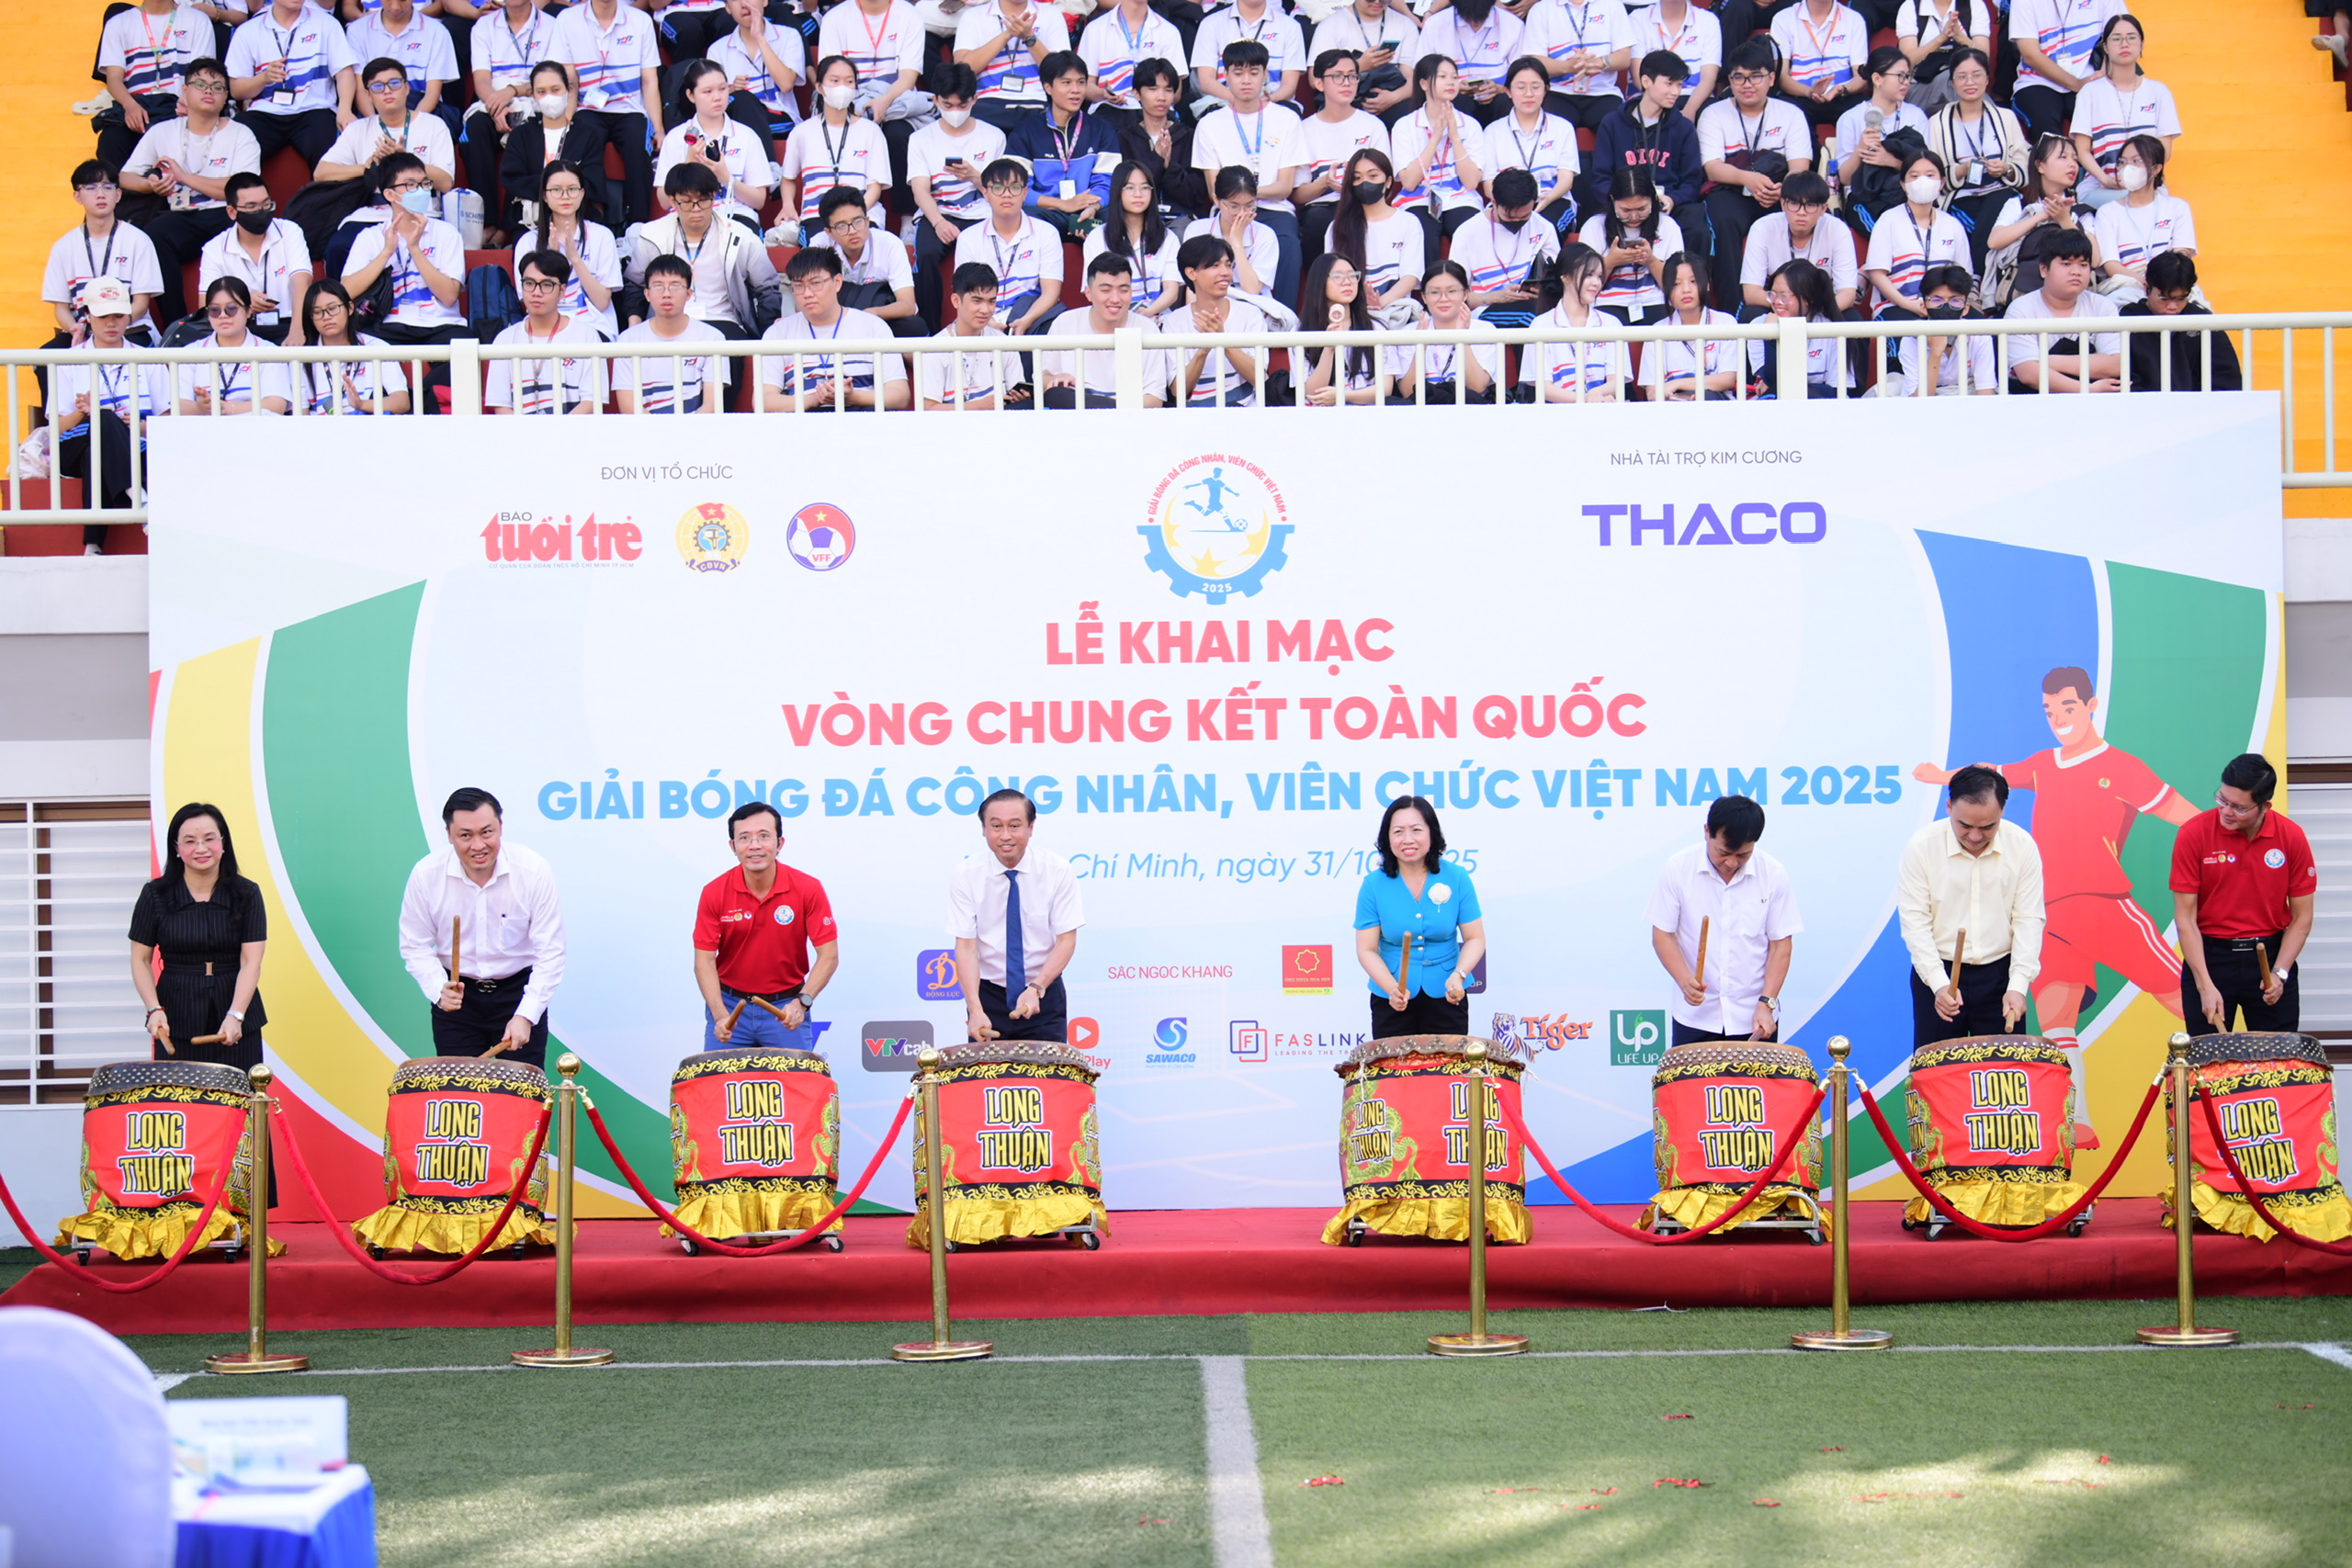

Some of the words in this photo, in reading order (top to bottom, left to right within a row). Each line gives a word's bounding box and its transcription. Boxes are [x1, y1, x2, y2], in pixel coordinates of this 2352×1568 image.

[601, 466, 637, 479] ĐƠN
[641, 467, 656, 483] VỊ
[660, 461, 683, 479] TỔ
[686, 462, 733, 479] CHỨC
[1611, 449, 1643, 465] NHÀ
[1647, 449, 1669, 465] TÀI
[1674, 451, 1706, 468] TRỢ
[1711, 451, 1737, 464] KIM
[1742, 450, 1803, 464] CƯƠNG
[1581, 502, 1827, 547] THACO
[812, 554, 831, 562] VFF
[1202, 582, 1233, 593] 2025
[1046, 600, 1103, 665] LỄ
[1119, 619, 1250, 664] KHAI
[1267, 617, 1395, 676] MẠC
[782, 691, 953, 747] VÒNG
[967, 697, 1171, 745] CHUNG
[1187, 681, 1287, 742] KẾT
[1300, 684, 1458, 741] TOÀN
[1472, 676, 1647, 740] QUỐC
[537, 767, 644, 820] GIẢI
[659, 768, 809, 820] BÓNG
[821, 768, 894, 818] ĐÁ
[1076, 763, 1234, 819] NHÂN,
[1246, 761, 1362, 811] VIÊN
[1375, 759, 1521, 810] CHỨC
[1532, 758, 1642, 821] VIỆT
[1656, 766, 1769, 807] NAM
[1780, 764, 1902, 806] 2025
[1126, 852, 1204, 882] Minh,
[1216, 852, 1296, 884] ngày
[1182, 964, 1233, 978] KHANG
[1275, 1033, 1366, 1046] FASLINK
[1520, 1013, 1594, 1052] Tiger
[1146, 1054, 1196, 1063] SAWACO
[1617, 1053, 1640, 1064] LIFE
[1643, 1054, 1659, 1064] UP
[727, 1081, 783, 1122] LONG
[985, 1088, 1042, 1128] LONG
[1706, 1086, 1763, 1128] LONG
[1972, 1070, 2029, 1111] LONG
[127, 1111, 184, 1153] LONG
[425, 1100, 481, 1141] LONG
[1965, 1109, 2040, 1155] THUẬN
[2221, 1099, 2281, 1142] LONG
[417, 1140, 488, 1187] THUẬN
[720, 1120, 793, 1167] THUẬN
[978, 1125, 1051, 1172] THUẬN
[1700, 1125, 1773, 1172] THUẬN
[2222, 1138, 2297, 1183] HUẬN
[119, 1151, 193, 1197] THUẬN
